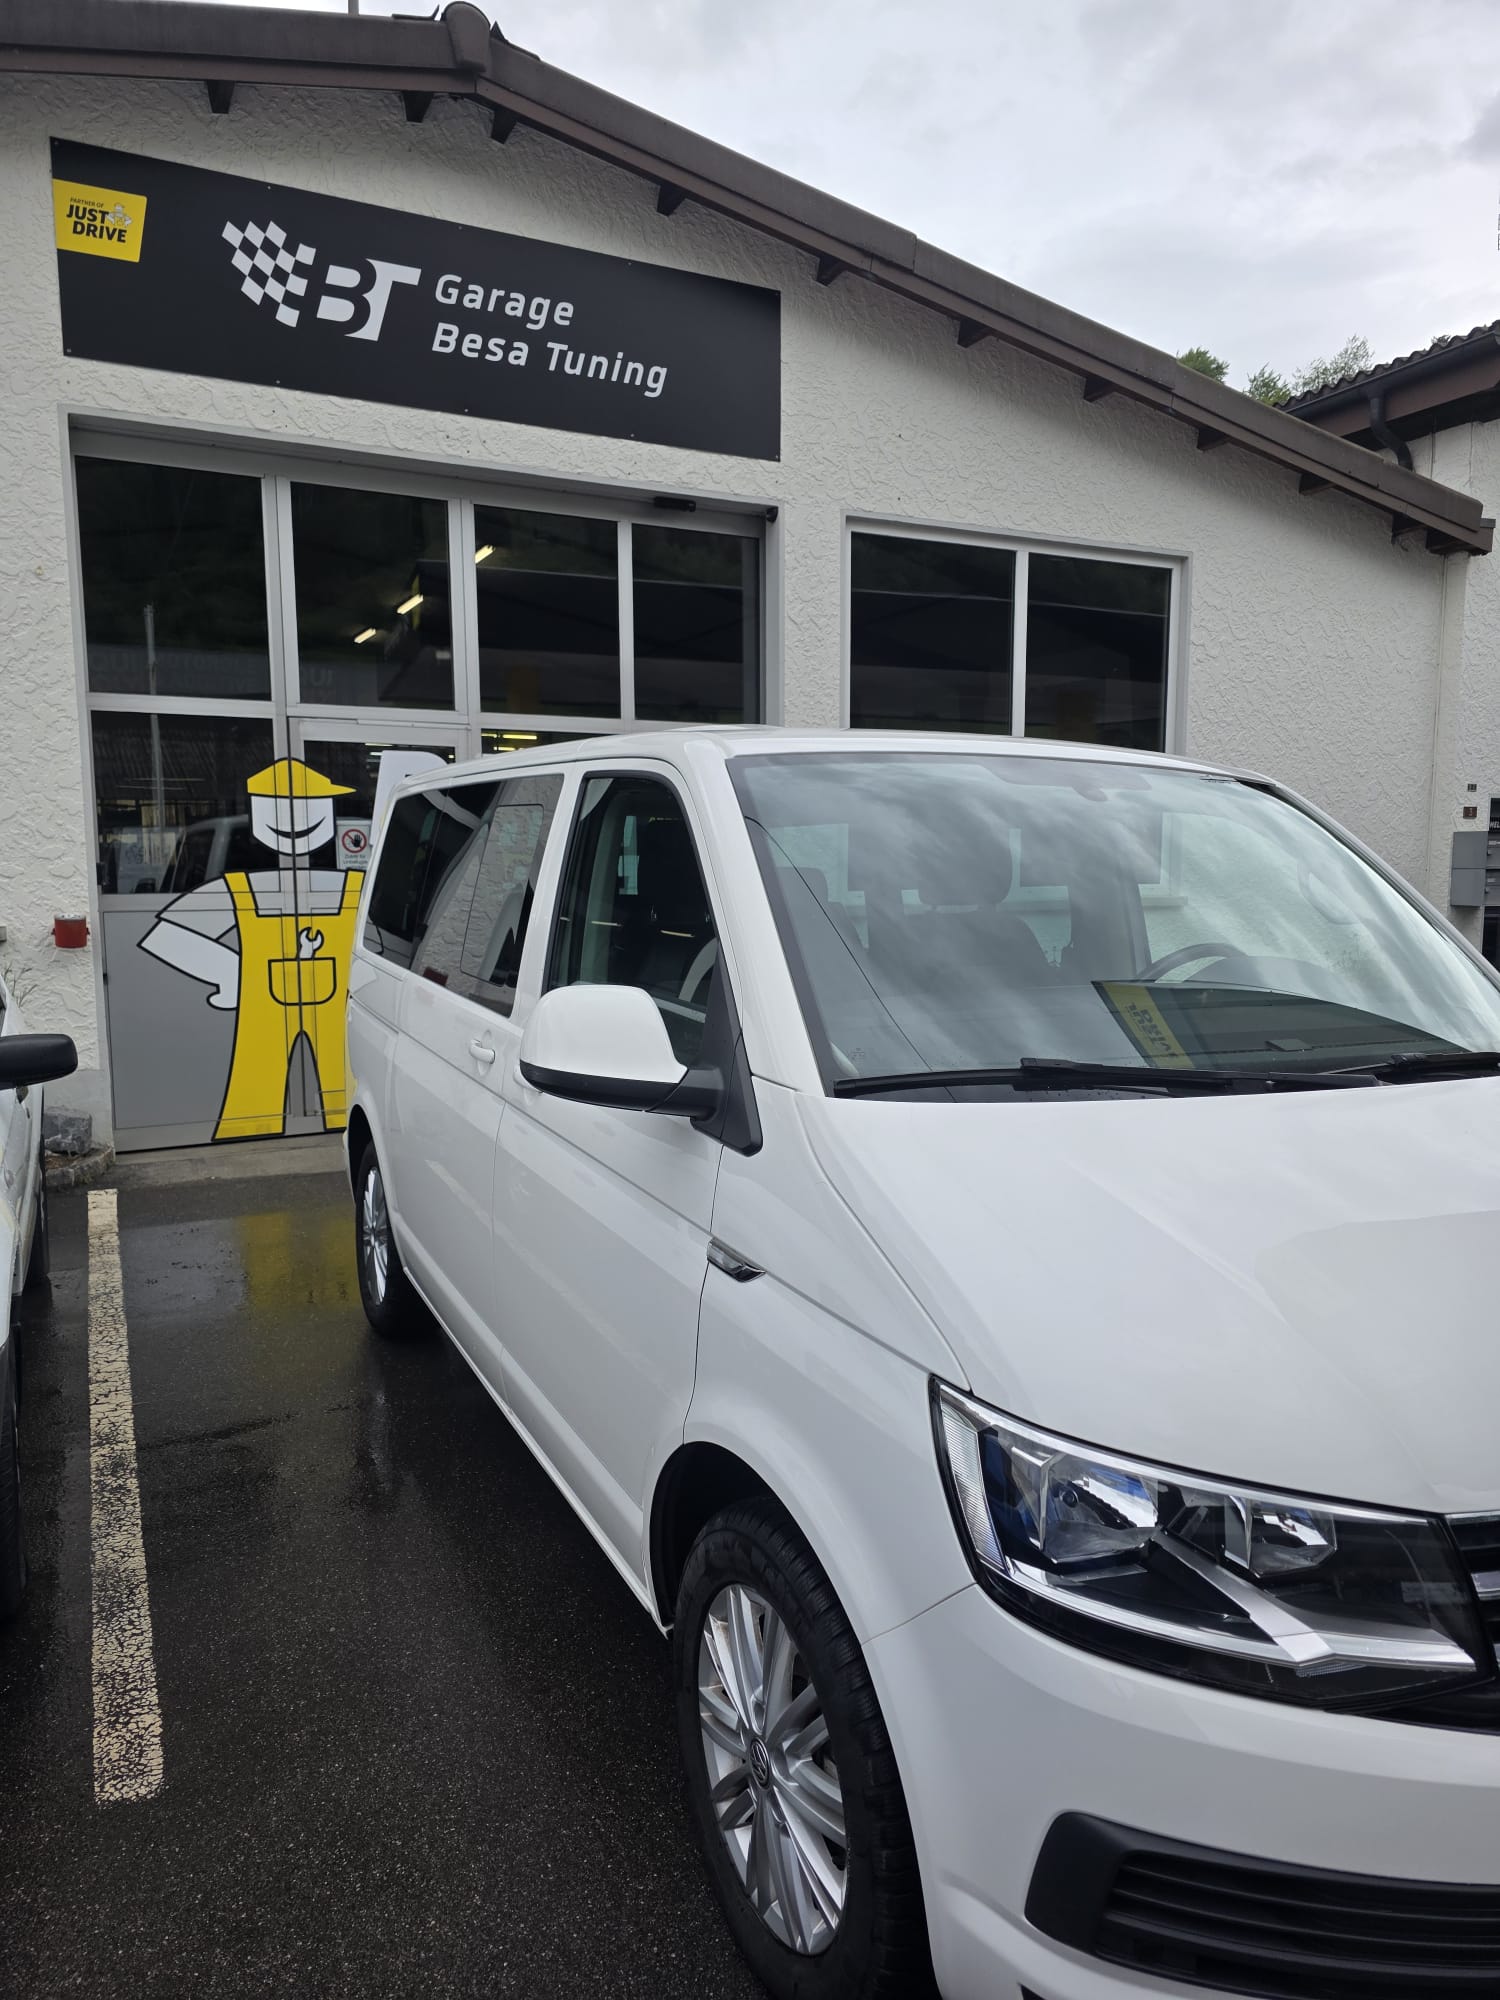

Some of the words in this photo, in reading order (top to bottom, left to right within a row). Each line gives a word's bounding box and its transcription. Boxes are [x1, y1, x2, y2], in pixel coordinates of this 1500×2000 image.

[70, 197, 96, 207] PARTNER
[66, 204, 109, 224] JUST
[72, 221, 127, 243] DRIVE
[435, 274, 574, 330] Garage
[432, 322, 529, 371] Besa
[547, 341, 668, 398] Tuning
